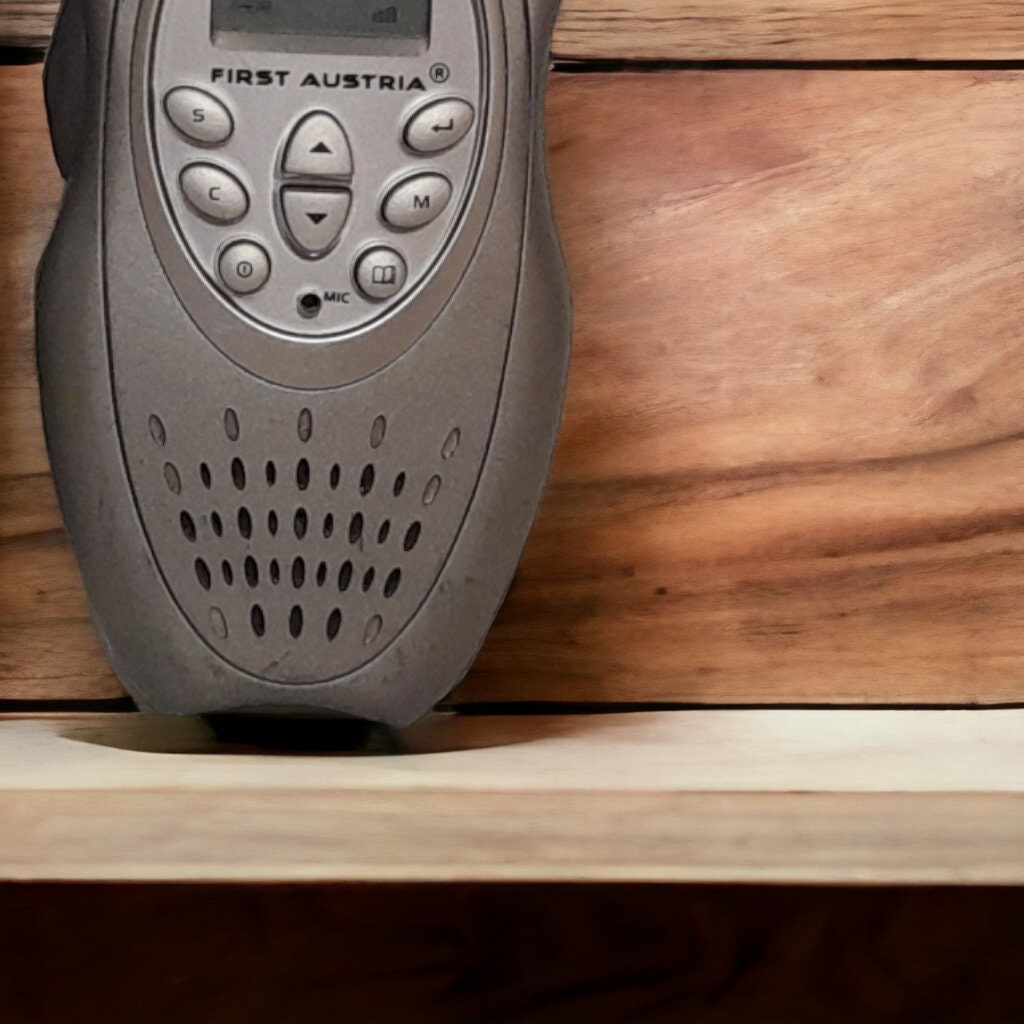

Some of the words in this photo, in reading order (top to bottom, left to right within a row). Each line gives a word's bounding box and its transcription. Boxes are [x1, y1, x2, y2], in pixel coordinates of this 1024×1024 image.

[211, 68, 290, 87] FIRST
[300, 72, 427, 92] AUSTRIA
[192, 108, 205, 123] S
[208, 187, 221, 201] C
[413, 195, 431, 209] M
[324, 292, 351, 304] MIC
